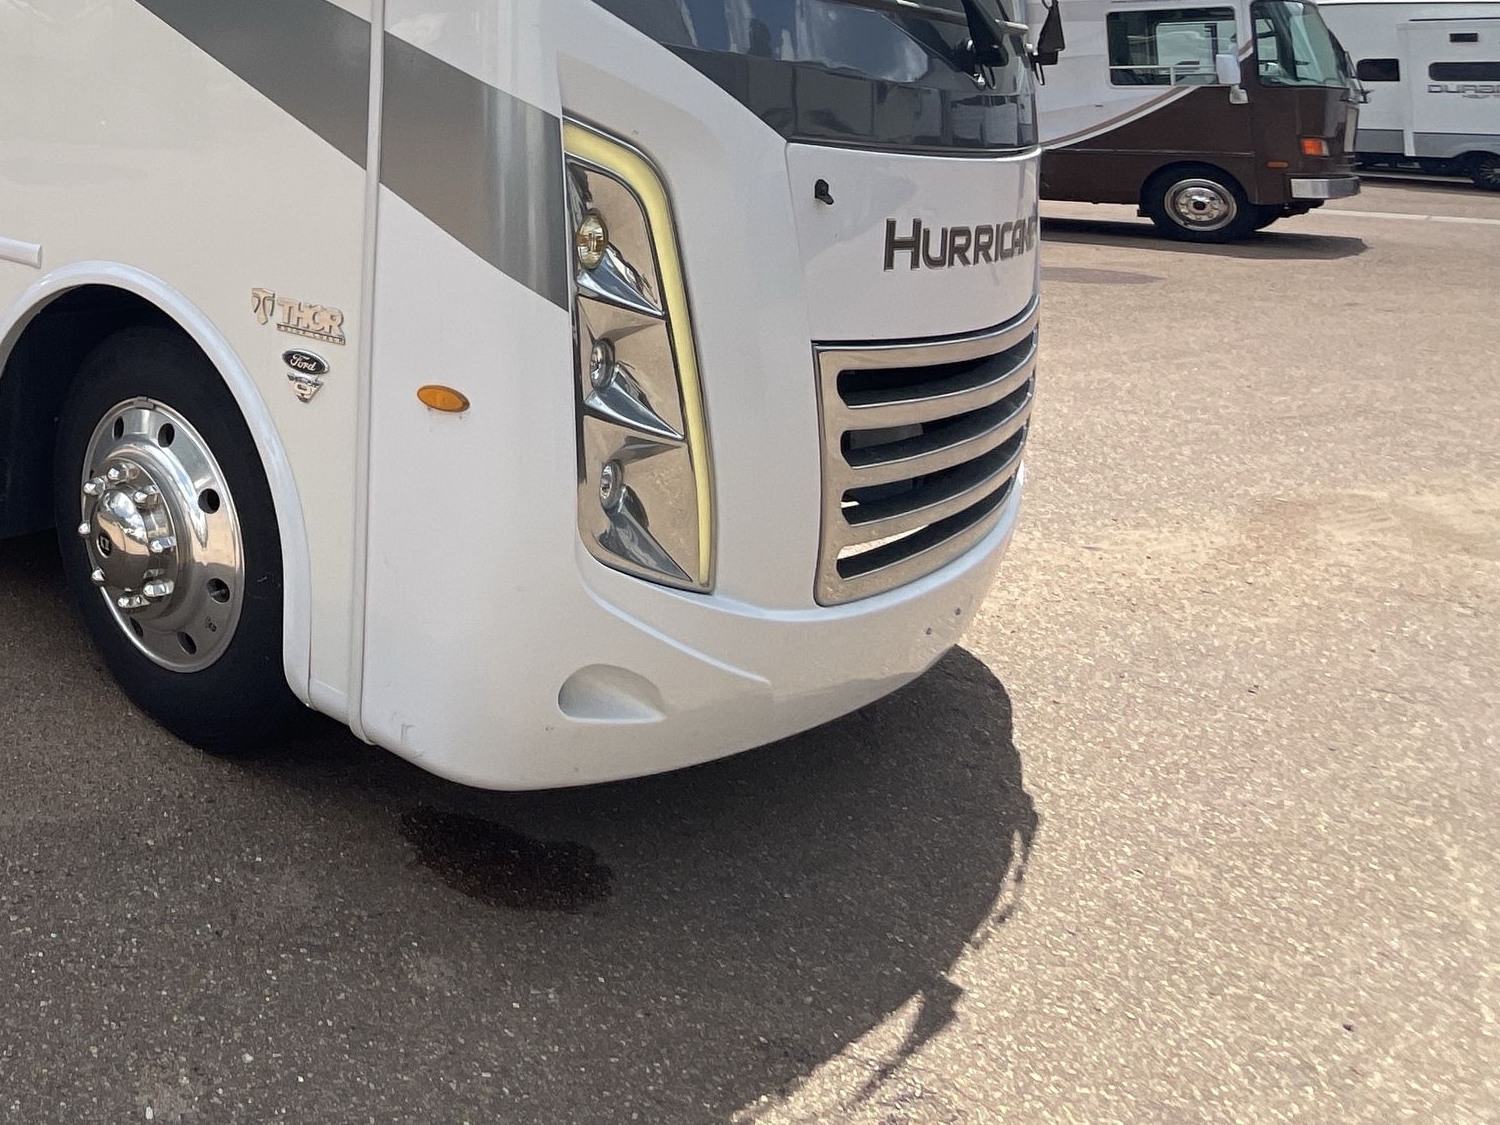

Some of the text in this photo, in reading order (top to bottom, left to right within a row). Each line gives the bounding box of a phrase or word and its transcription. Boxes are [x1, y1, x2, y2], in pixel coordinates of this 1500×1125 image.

[1427, 84, 1500, 94] DURA
[277, 297, 345, 336] THOR
[289, 353, 317, 372] Ford
